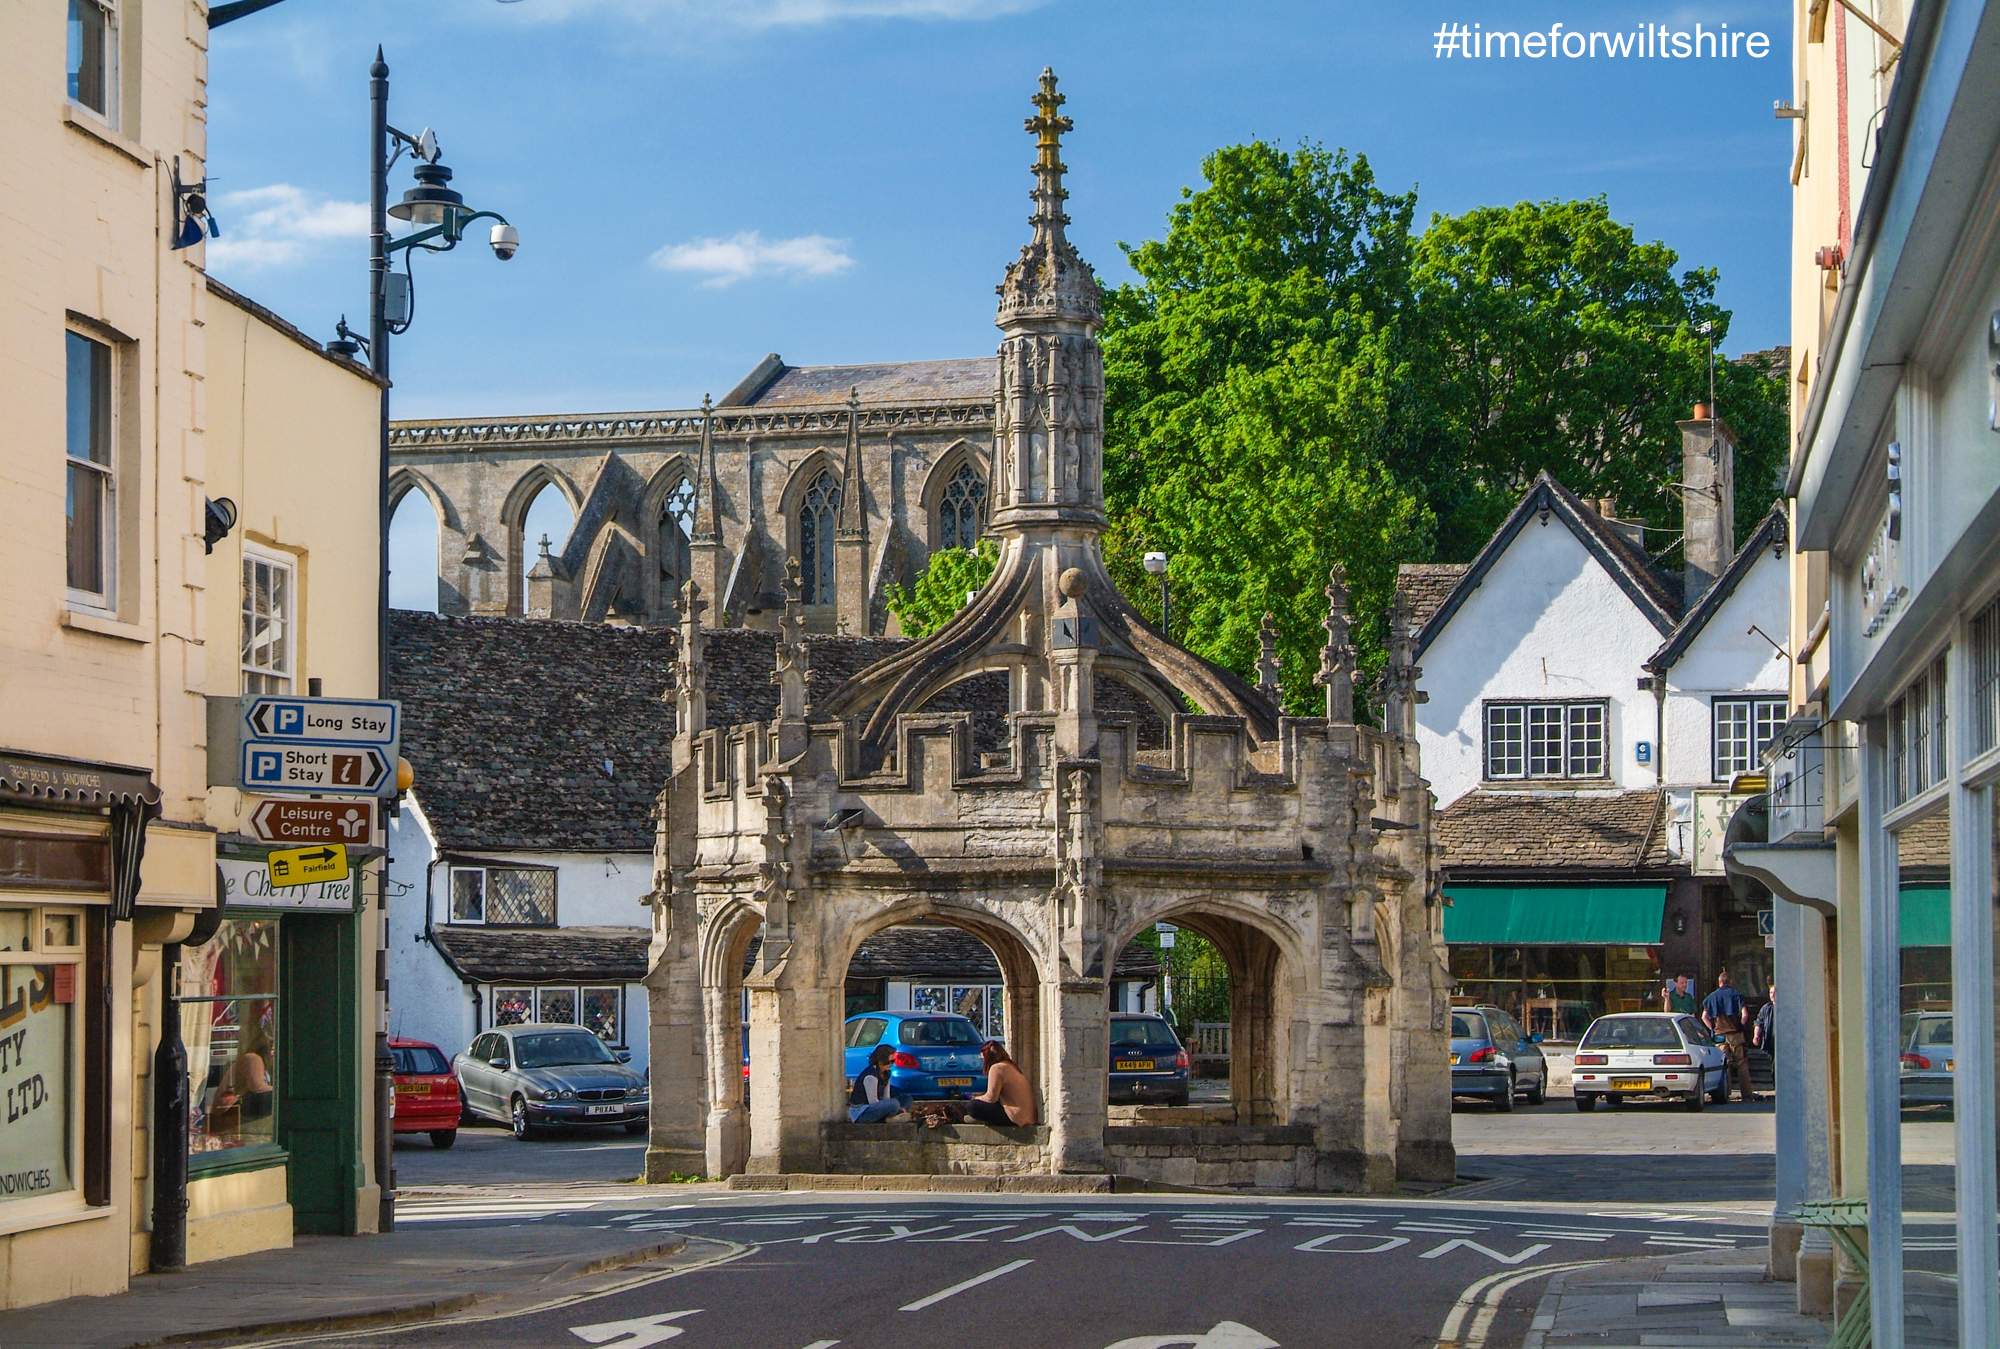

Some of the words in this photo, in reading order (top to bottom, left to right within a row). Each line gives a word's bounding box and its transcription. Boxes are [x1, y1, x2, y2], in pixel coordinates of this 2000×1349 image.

[280, 709, 298, 730] P
[307, 714, 343, 731] Long
[351, 717, 386, 733] Stay
[258, 756, 276, 777] P
[285, 751, 327, 765] Short
[9, 764, 29, 780] FRESH
[29, 768, 50, 783] BREAD
[62, 772, 101, 788] SANDWICHES
[288, 768, 324, 783] Stay
[280, 806, 333, 821] Leisure
[280, 822, 331, 837] Centre
[303, 862, 336, 873] Fairfield
[7, 1073, 49, 1124] LTD.
